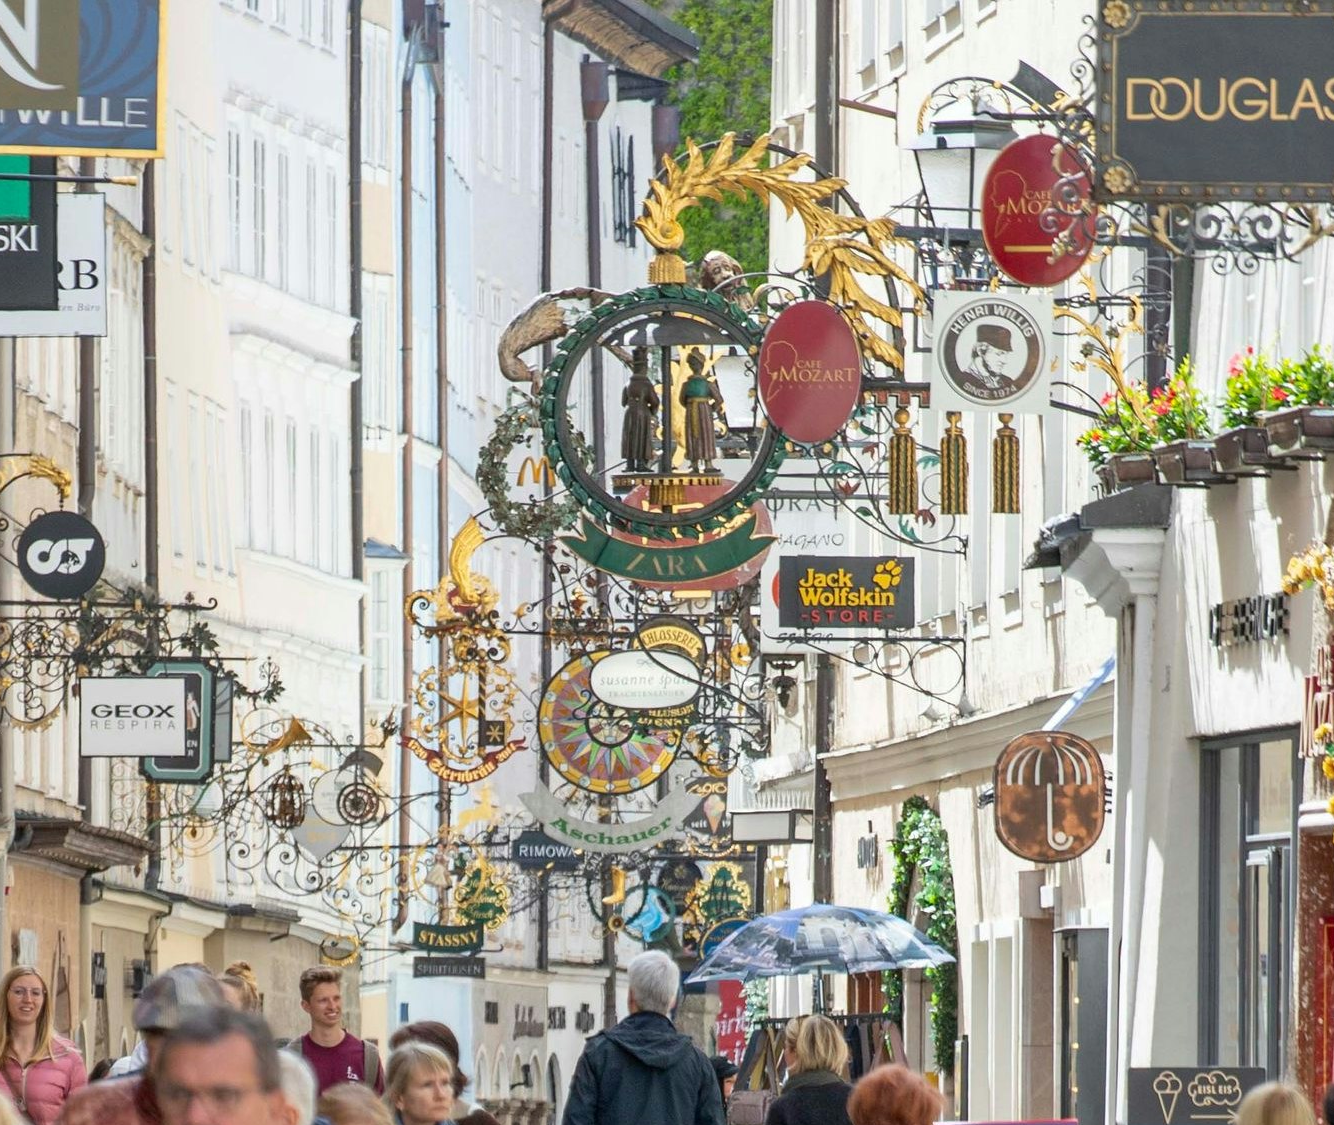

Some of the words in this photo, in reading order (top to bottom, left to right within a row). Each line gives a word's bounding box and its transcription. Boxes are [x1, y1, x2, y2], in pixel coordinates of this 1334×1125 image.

[950, 304, 989, 335] HENRI
[993, 304, 1034, 338] WILLIG
[779, 365, 856, 383] MOZART
[962, 381, 990, 399] SINCE
[992, 384, 1018, 399] 1974
[625, 552, 709, 577] ZARA
[798, 568, 854, 589] Jack
[798, 587, 896, 607] Wolfskin
[599, 675, 655, 687] susanne
[90, 704, 175, 719] GEOX
[89, 719, 176, 730] RESPIRA
[550, 816, 672, 846] Aschauer
[518, 844, 577, 858] RIMOWA
[417, 929, 479, 947] STASSNY
[1196, 1084, 1217, 1096] EISL
[1218, 1084, 1234, 1095] EIS
